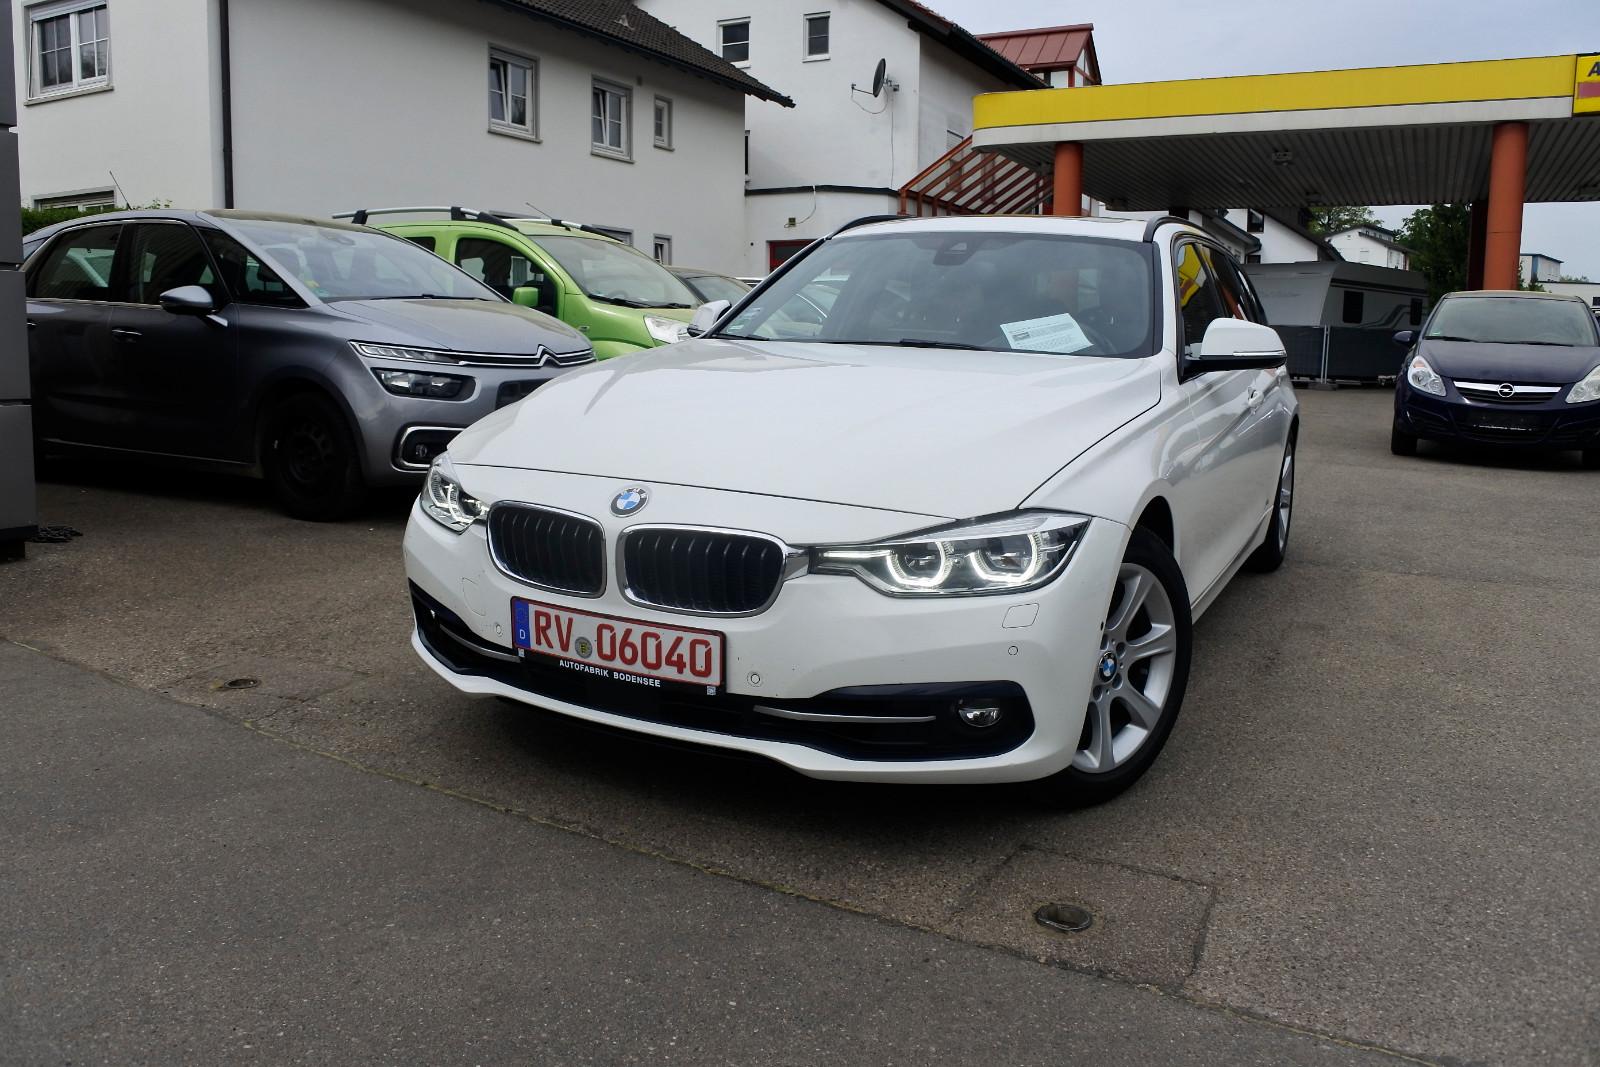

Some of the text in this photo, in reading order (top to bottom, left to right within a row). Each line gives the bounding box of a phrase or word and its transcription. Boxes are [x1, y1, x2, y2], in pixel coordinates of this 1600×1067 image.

[519, 629, 526, 640] D
[534, 610, 712, 678] RV 06040
[560, 660, 661, 687] AUTOFABRIK BODENSEE
